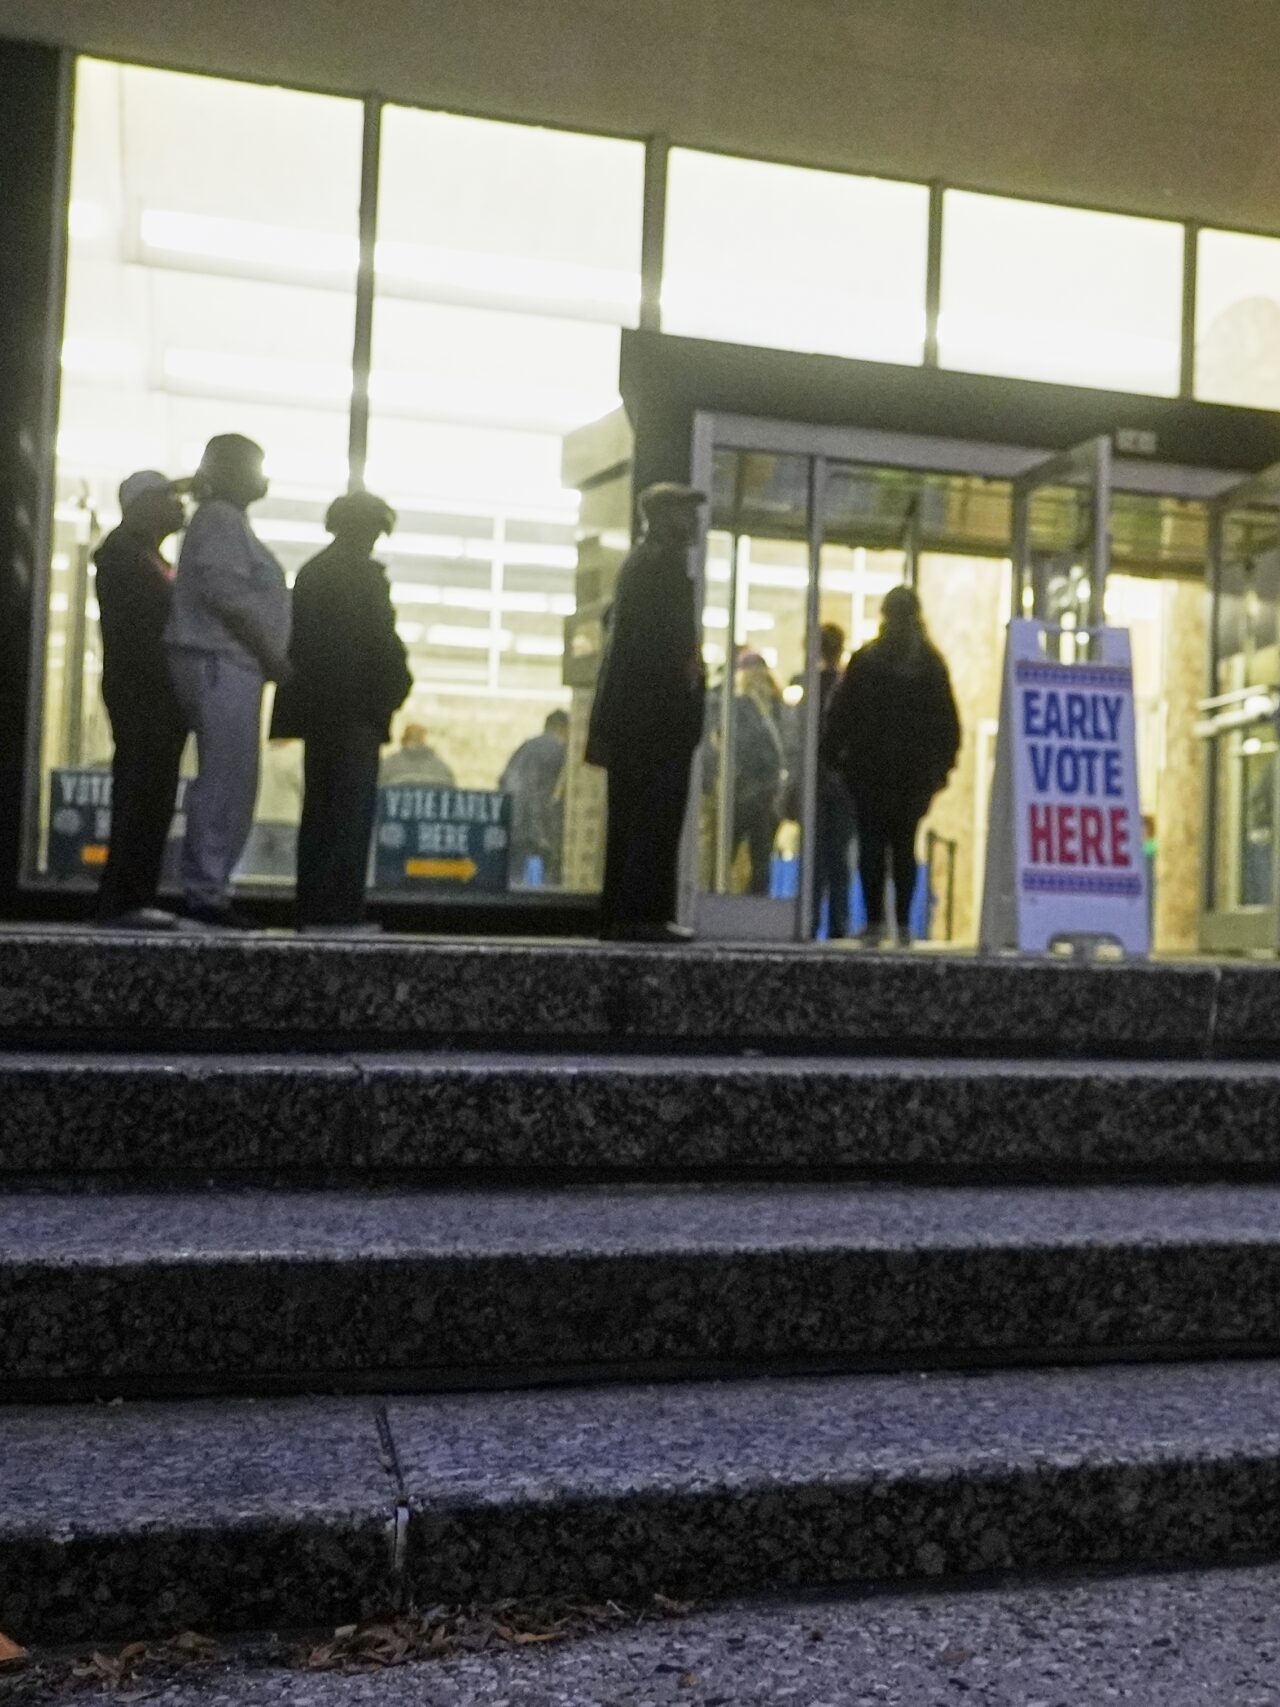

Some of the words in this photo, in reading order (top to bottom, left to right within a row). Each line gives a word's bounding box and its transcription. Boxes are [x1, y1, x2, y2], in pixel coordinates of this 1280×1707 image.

[1023, 690, 1123, 741] EARLY
[1029, 744, 1123, 796] VOTE
[386, 788, 438, 818] VOTE
[440, 790, 503, 822] EARLY
[418, 821, 469, 852] HERE
[1029, 803, 1131, 866] HERE
